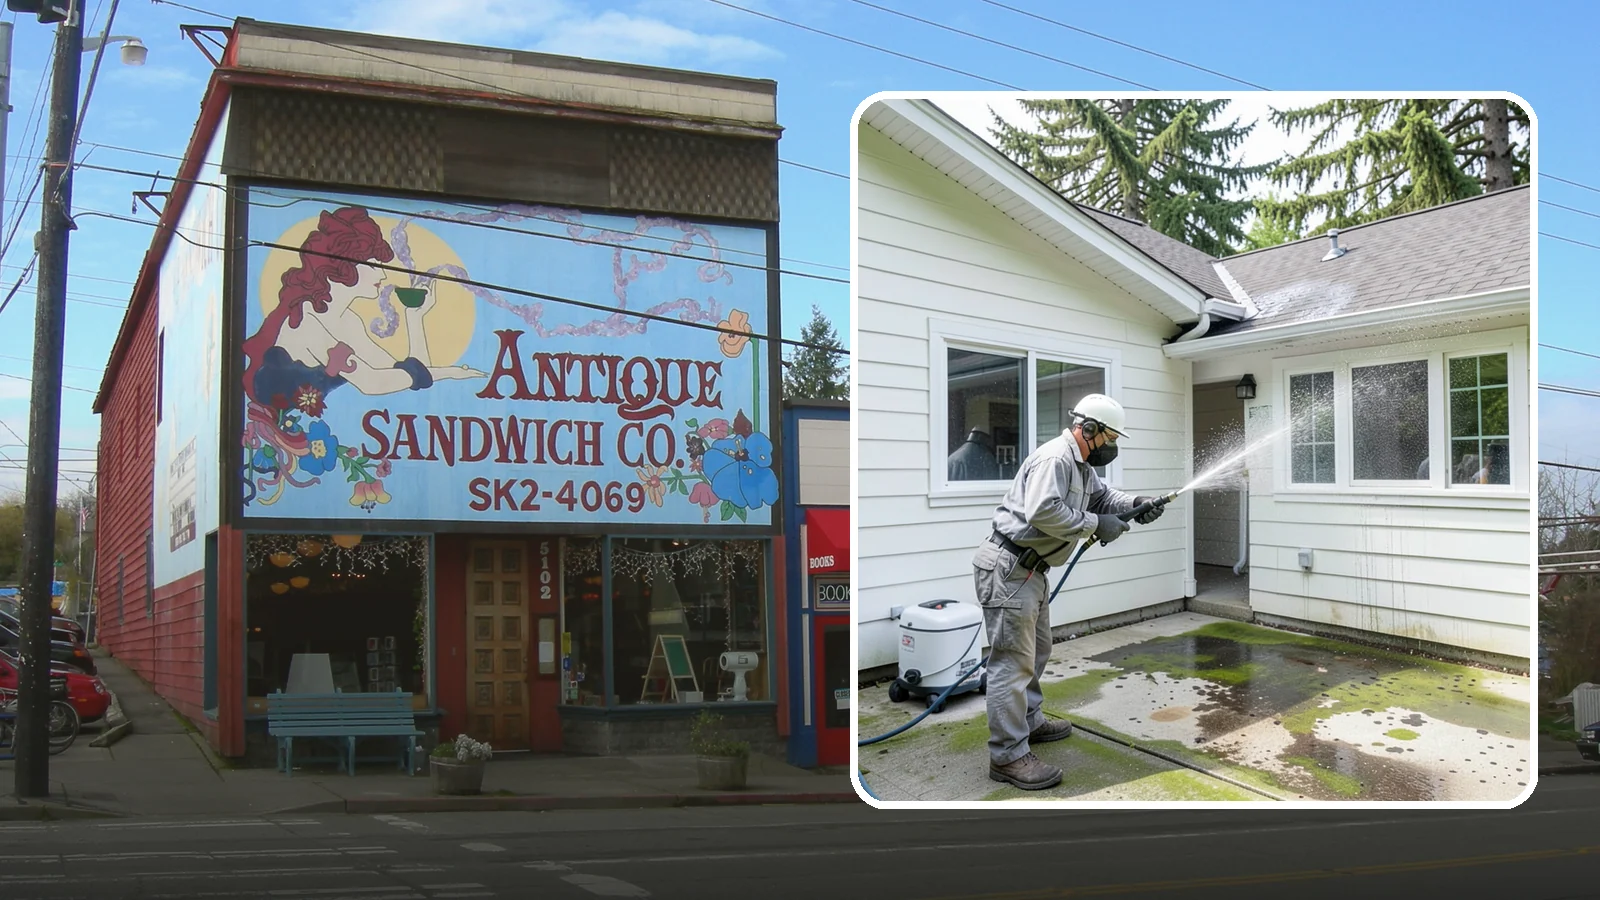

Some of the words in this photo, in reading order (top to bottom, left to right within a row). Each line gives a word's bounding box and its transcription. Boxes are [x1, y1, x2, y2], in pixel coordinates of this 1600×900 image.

[476, 329, 723, 420] ANTIQUE
[361, 409, 604, 467] SANDWICH
[617, 422, 685, 468] CO.
[468, 477, 645, 513] SK2-4069
[540, 541, 552, 599] 5102
[809, 555, 834, 568] BOOKS
